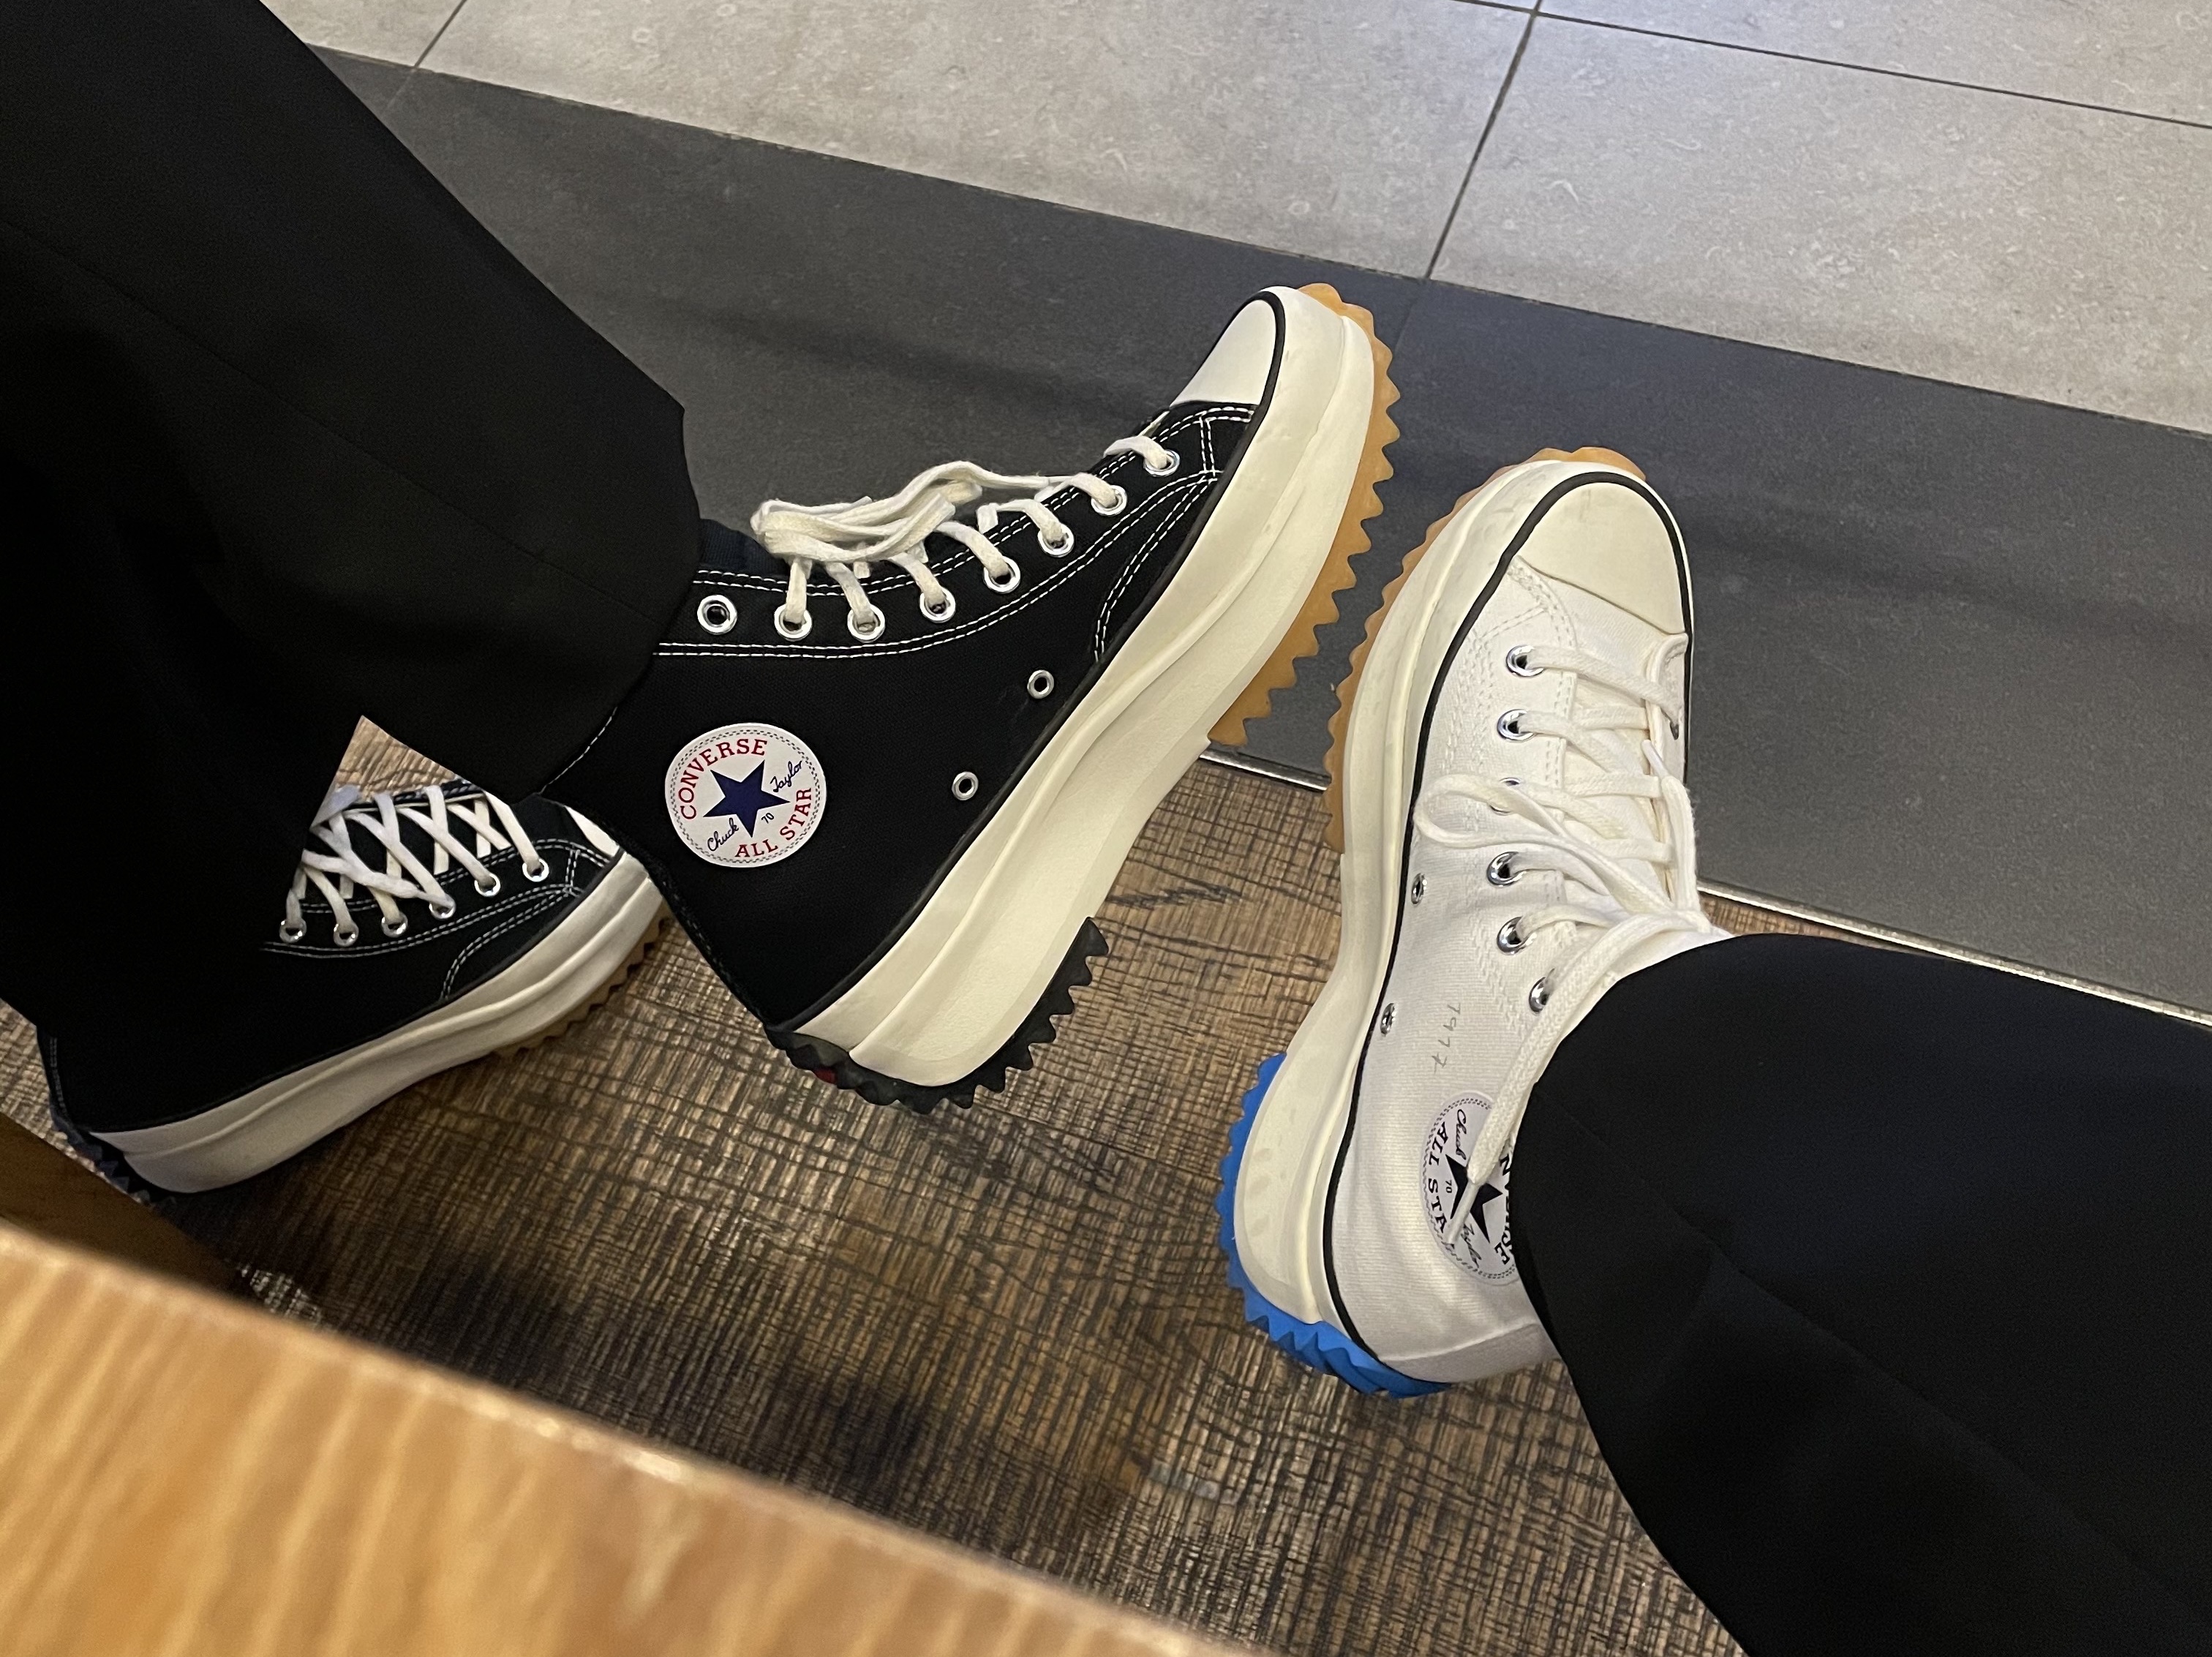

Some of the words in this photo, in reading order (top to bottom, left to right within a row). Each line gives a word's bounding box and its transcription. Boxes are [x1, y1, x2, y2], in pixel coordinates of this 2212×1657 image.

[678, 738, 768, 820] CONVERSE
[707, 817, 740, 852] Chuck
[770, 760, 802, 793] Taylor
[734, 838, 778, 858] ALL
[780, 787, 812, 841] STAR
[761, 812, 775, 824] 70
[1429, 1121, 1449, 1166] ALL
[1428, 1177, 1454, 1250] STA
[1445, 1179, 1453, 1194] 70
